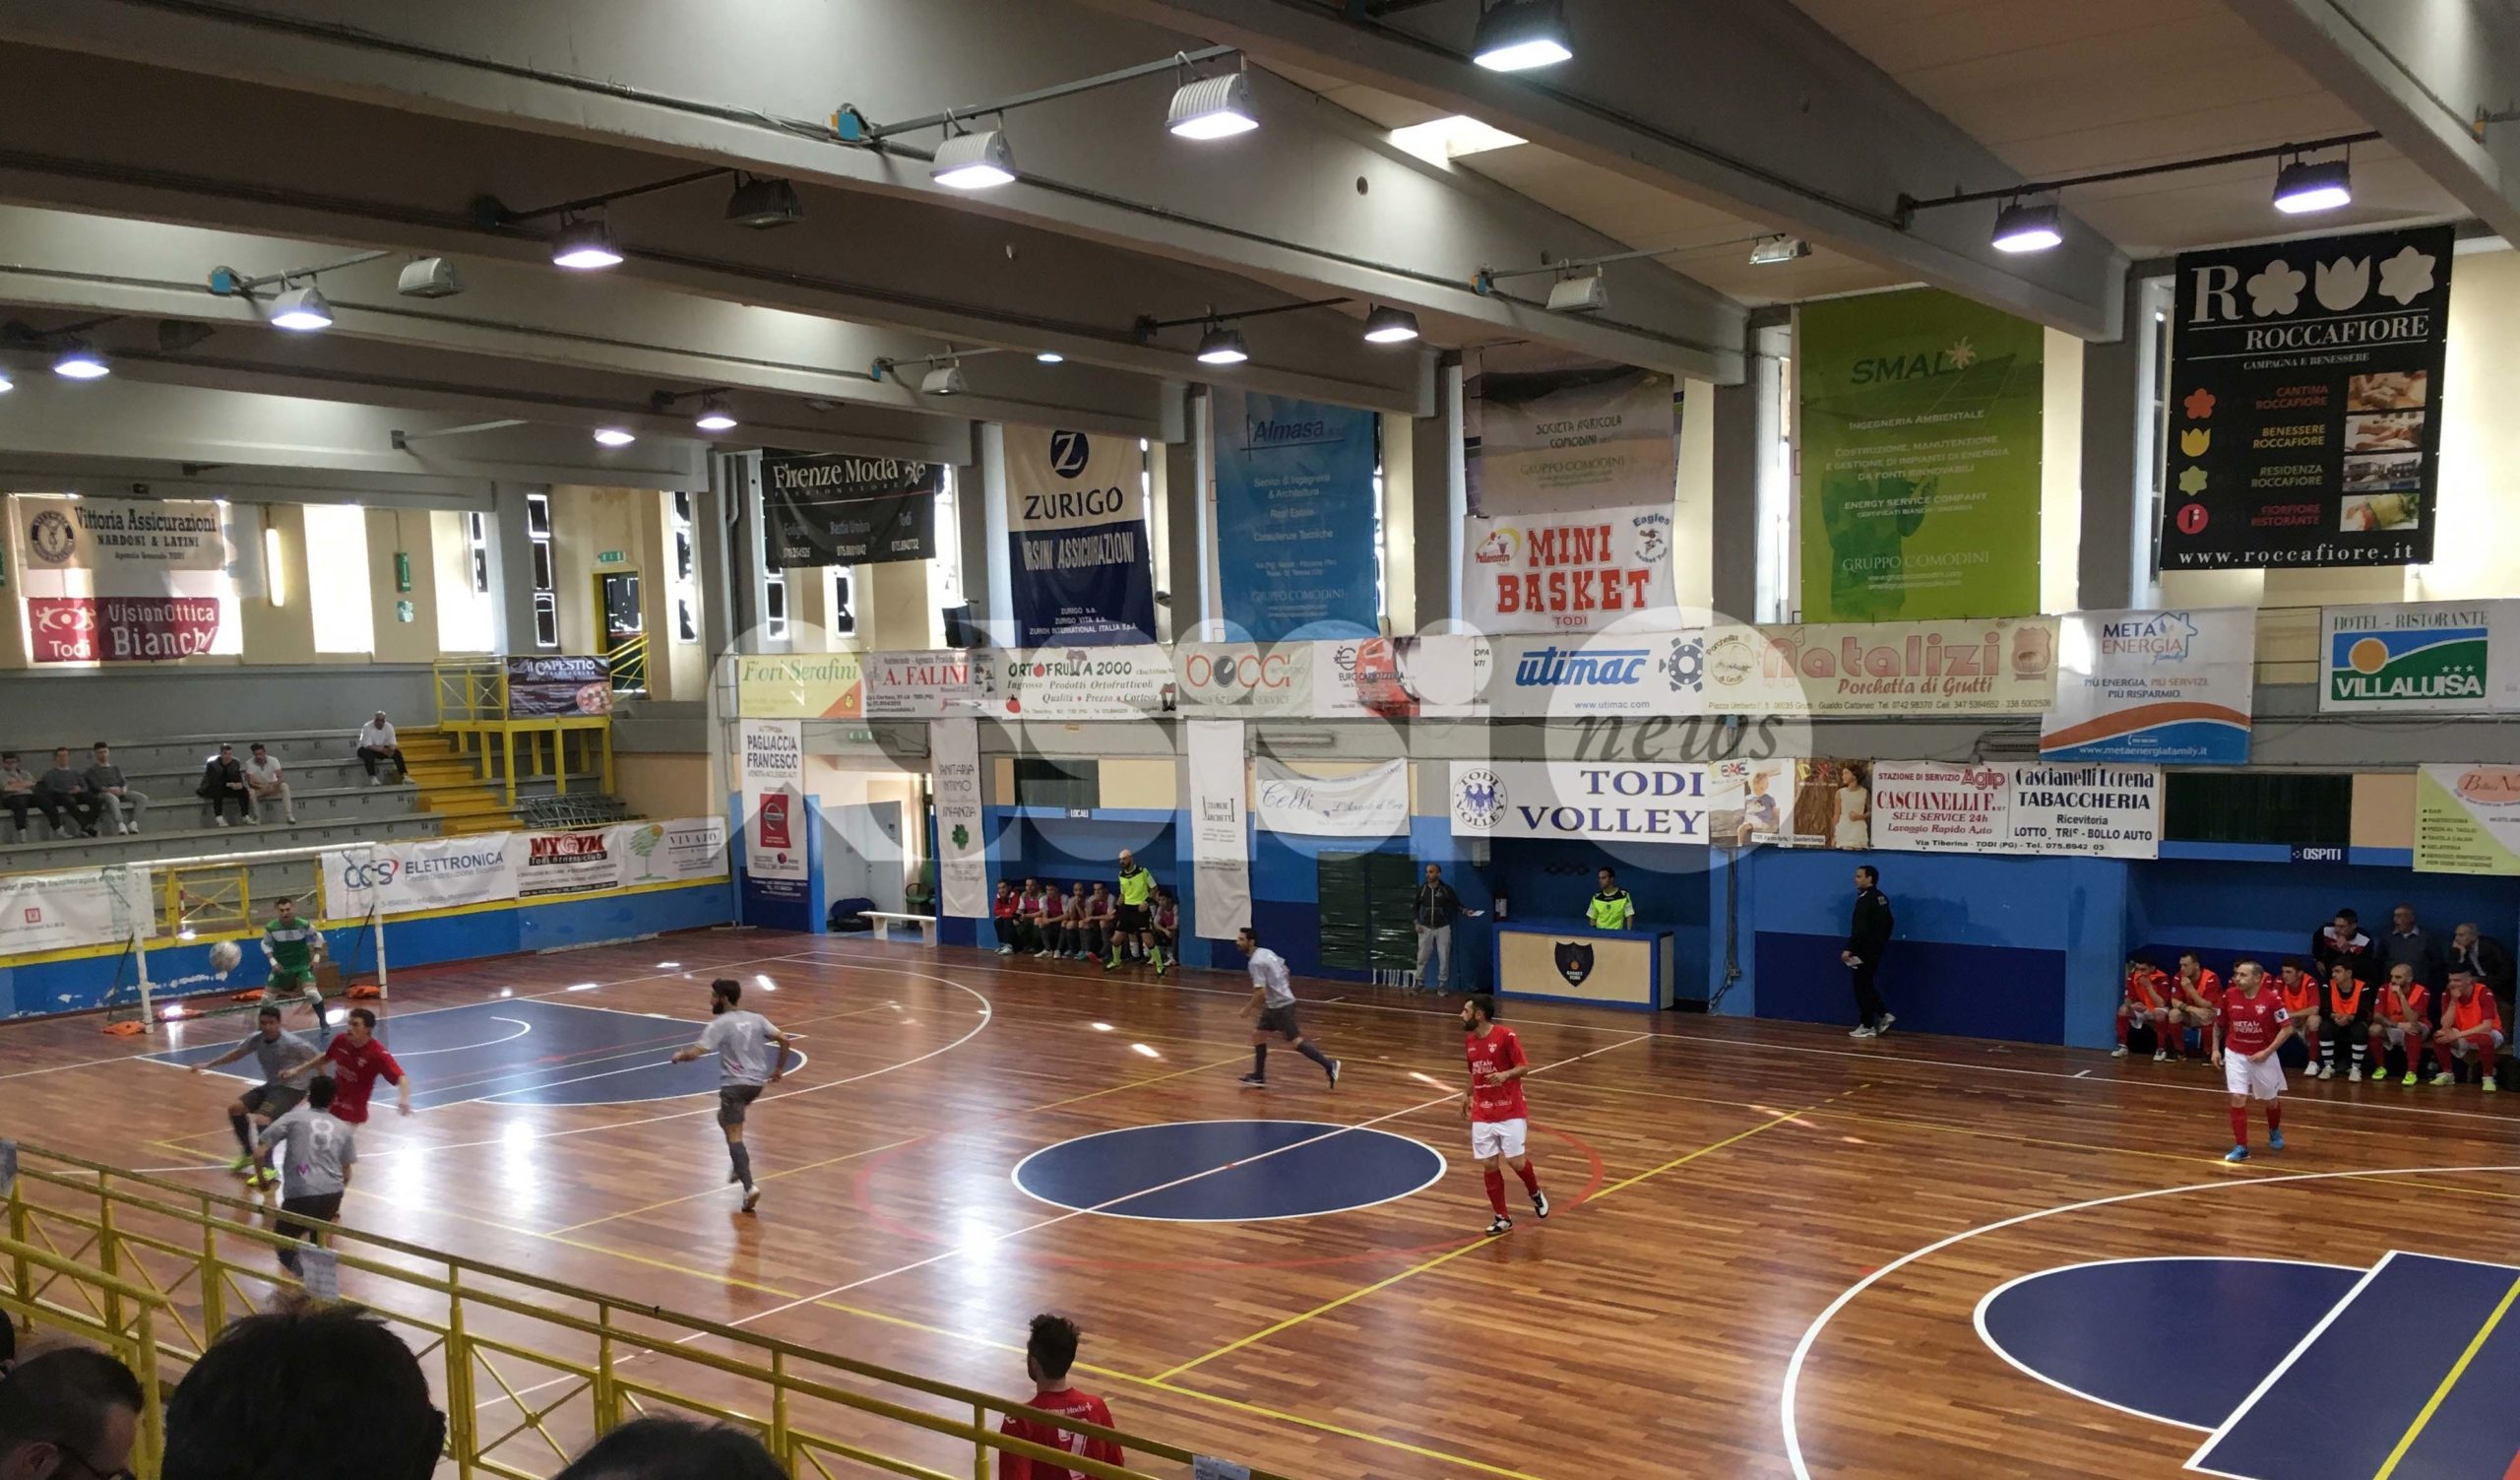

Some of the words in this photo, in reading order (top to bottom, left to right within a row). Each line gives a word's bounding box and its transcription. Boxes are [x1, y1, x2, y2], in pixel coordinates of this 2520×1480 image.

[2244, 314, 2429, 351] ROCCAFIORE
[2243, 357, 2298, 370] CAMPAGNA
[2300, 356, 2307, 365] E
[2310, 353, 2369, 365] BENESSERE
[2277, 385, 2328, 397] CANTINA
[2256, 396, 2328, 409] ROCCAFIORE
[1253, 420, 1324, 442] Almasa
[1577, 415, 1621, 431] AGRICOLA
[2262, 424, 2326, 436] BENESSERE
[1549, 434, 1597, 449] COMODINI
[2253, 435, 2325, 449] ROCCAFIORE
[773, 462, 842, 489] Firenze
[845, 456, 899, 483] Moda
[2260, 465, 2323, 477] RESIDENZA
[2251, 476, 2323, 487] ROCCAFIORE
[1023, 485, 1124, 521] ZURIGO
[1844, 499, 1884, 510] ENERGY
[1887, 496, 1930, 507] SERVICE
[1934, 492, 1987, 504] COMPANY
[75, 506, 124, 531] Vittoria
[128, 508, 217, 533] Assicurazioni
[1633, 513, 1670, 528] Eagles
[2251, 514, 2320, 527] RISTORANTE
[97, 535, 146, 547] NARDONI
[152, 536, 158, 547] &
[163, 535, 200, 547] LATINI
[1528, 524, 1612, 568] MINI
[1057, 530, 1134, 570] ASSICURAZIONI
[2179, 543, 2414, 564] www.roccafiore.it
[1843, 555, 1902, 572] GRUPPO
[1905, 551, 1989, 568] COMODINI
[1289, 589, 1344, 601] COMODINI
[1497, 569, 1651, 614] BASKET
[108, 603, 215, 622] VisionOttica
[1553, 614, 1587, 626] TODI
[2334, 615, 2378, 631] HOTEL
[2396, 611, 2489, 628] RISTORANTE
[1099, 623, 1120, 632] ITALIA
[2104, 622, 2156, 638] META
[49, 640, 92, 658] Todi
[111, 626, 212, 656] Bianch
[2102, 639, 2182, 655] ENERGIA
[788, 658, 858, 684] Serafini
[883, 668, 901, 685] A.
[906, 665, 968, 685] FALINI
[1097, 661, 1132, 676] 2000
[1515, 646, 1651, 687] utimac
[1008, 680, 1042, 691] Ingrosso
[1049, 680, 1086, 690] Prodotti
[1090, 679, 1154, 689] Ortofrutticoli
[1838, 677, 1915, 695] Porchetta
[1921, 676, 1937, 695] di
[1943, 676, 1992, 698] Grutti
[2109, 688, 2123, 698] PIÙ
[2126, 689, 2182, 698] RISPARMIO.
[2336, 674, 2483, 698] VILLALUISA
[1086, 693, 1113, 702] Prezzo
[1124, 693, 1157, 702] Cortesia
[1574, 700, 1650, 709] www.utimac.com
[747, 735, 797, 751] PAGLIACCIA
[2079, 746, 2208, 757] www.metaenergiafamily.it
[747, 752, 798, 769] FRANCESCO
[1457, 770, 1500, 787] TODI
[1580, 770, 1706, 797] TODI
[1878, 772, 1915, 781] STAZIONE
[1917, 772, 1923, 781] DI
[1924, 772, 1960, 782] SERVIZIO
[1961, 768, 2005, 790] Agip
[2016, 767, 2096, 788] Cascianelli
[2101, 768, 2155, 789] Lorena
[1261, 779, 1314, 811] Celli
[1876, 791, 1976, 810] CASCIANELLI
[2019, 791, 2150, 809] TABACCHERIA
[1070, 808, 1089, 818] LOCALI
[1457, 803, 1505, 828] VOLLEY
[1517, 805, 1707, 835] VOLLEY
[1892, 811, 1918, 821] SELF
[1920, 811, 1966, 822] SERVICE
[1969, 812, 1988, 822] 24h
[2056, 813, 2109, 825] Ricevitoria
[1888, 823, 1928, 835] Lavaggio
[1932, 824, 1966, 835] Rapido
[1969, 825, 1992, 835] Auto
[2015, 827, 2047, 838] LOTTO
[2088, 828, 2120, 839] BOLLO
[2124, 829, 2153, 840] AUTO
[530, 834, 604, 857] MYGYM
[406, 852, 503, 874] ELETTRONICA
[583, 853, 601, 862] club
[2303, 848, 2341, 861] OSPITI
[310, 1119, 335, 1151] 8
